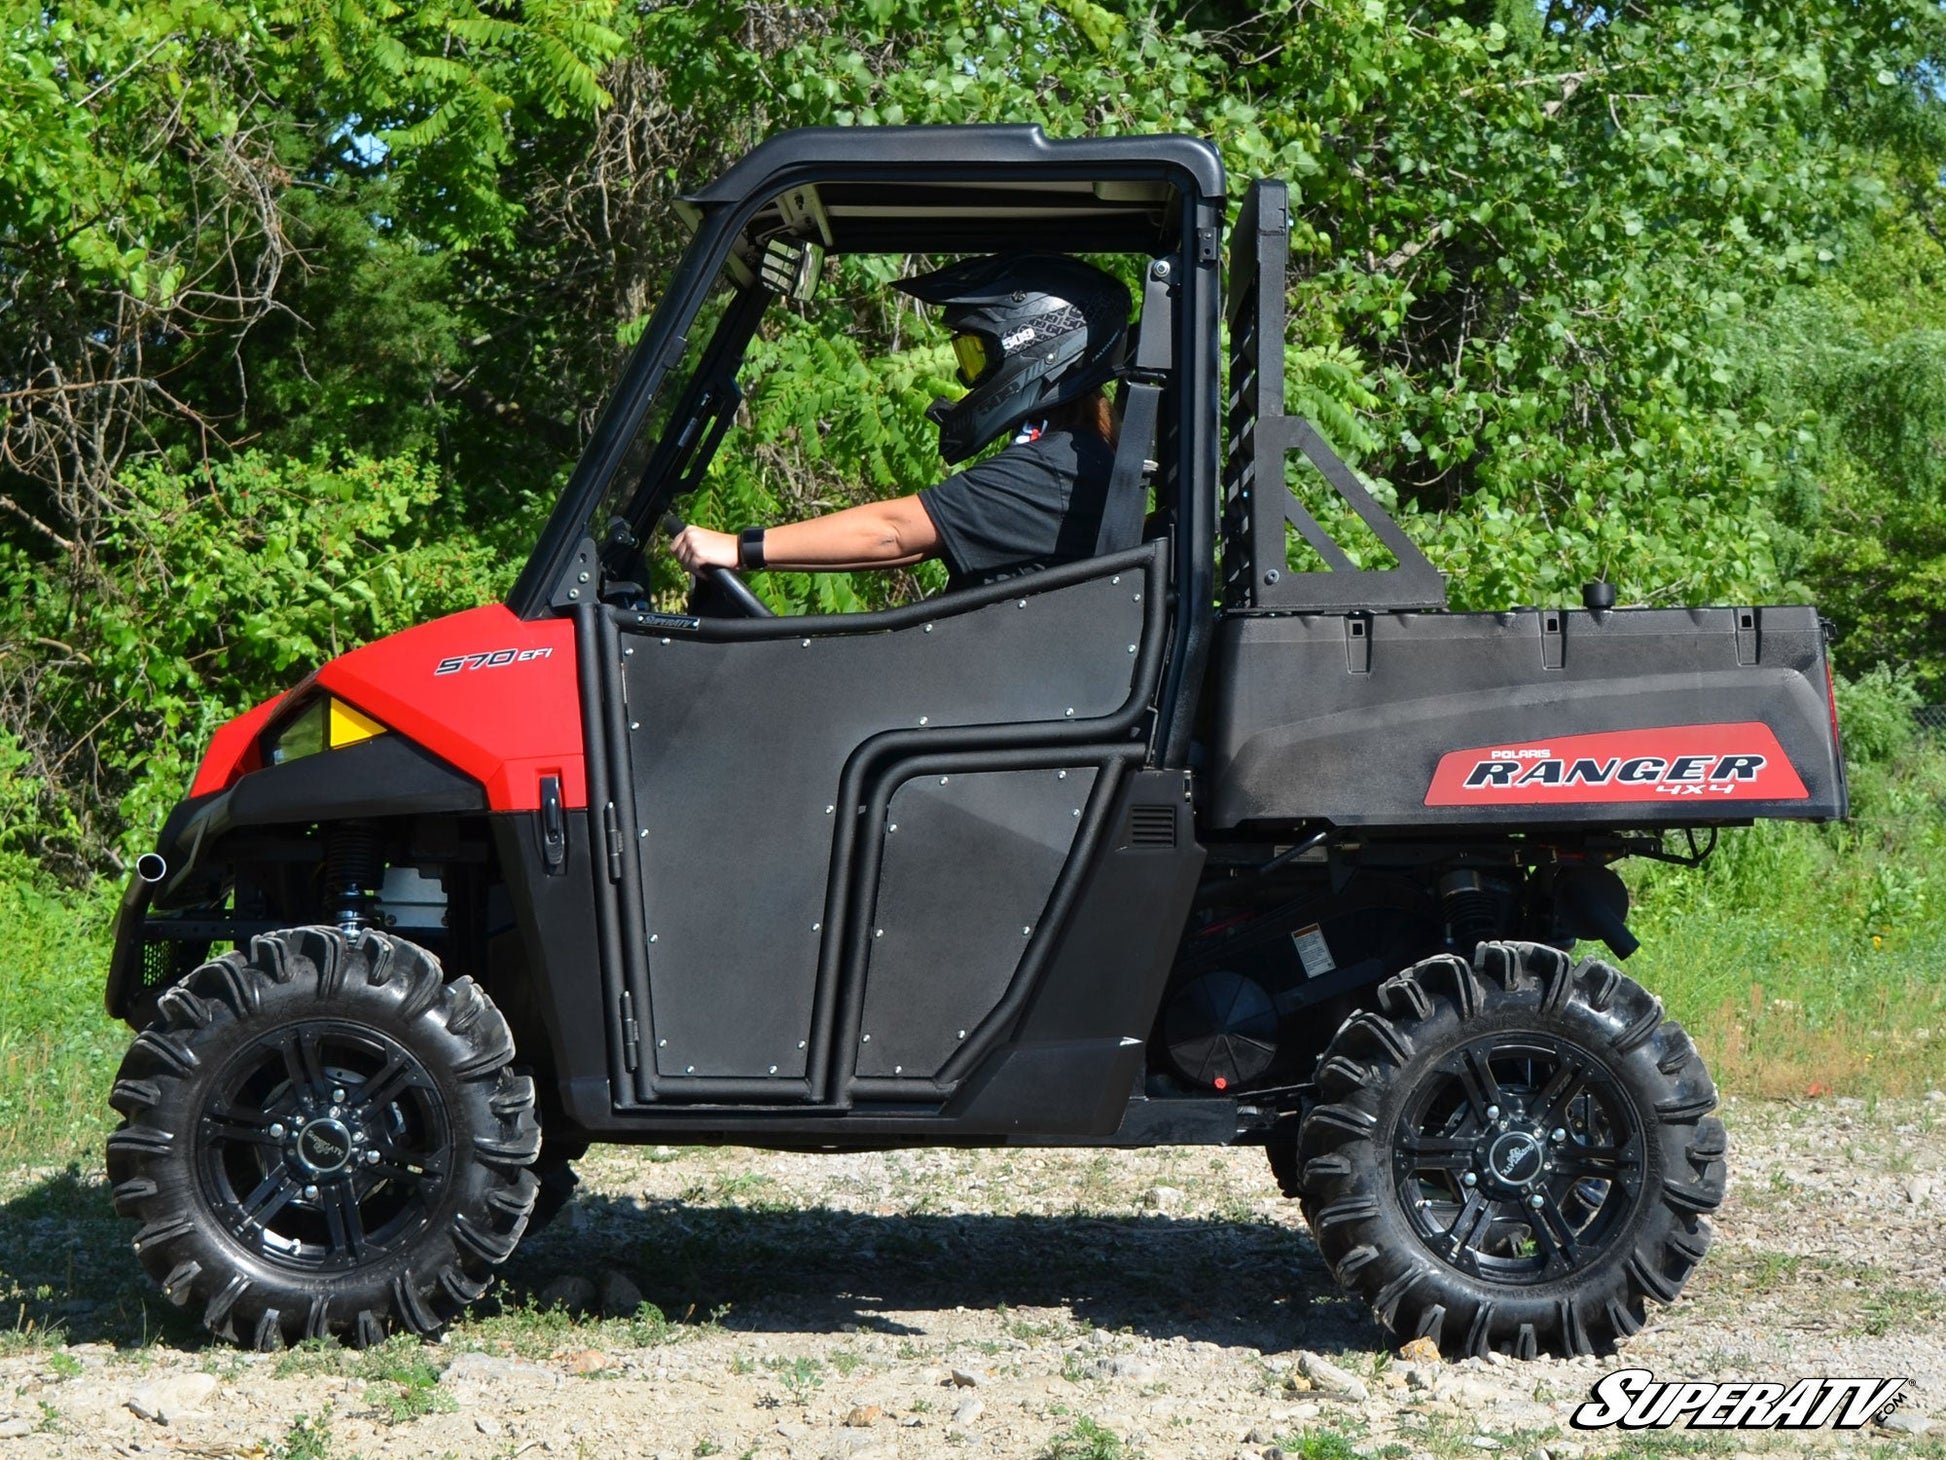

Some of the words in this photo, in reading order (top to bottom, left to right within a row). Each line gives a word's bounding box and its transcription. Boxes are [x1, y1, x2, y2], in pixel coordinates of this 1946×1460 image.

[1001, 328, 1035, 350] 509
[434, 648, 518, 676] 570
[517, 648, 553, 662] EFI
[1491, 748, 1551, 760] POLARIS
[1462, 754, 1768, 790] RANGER
